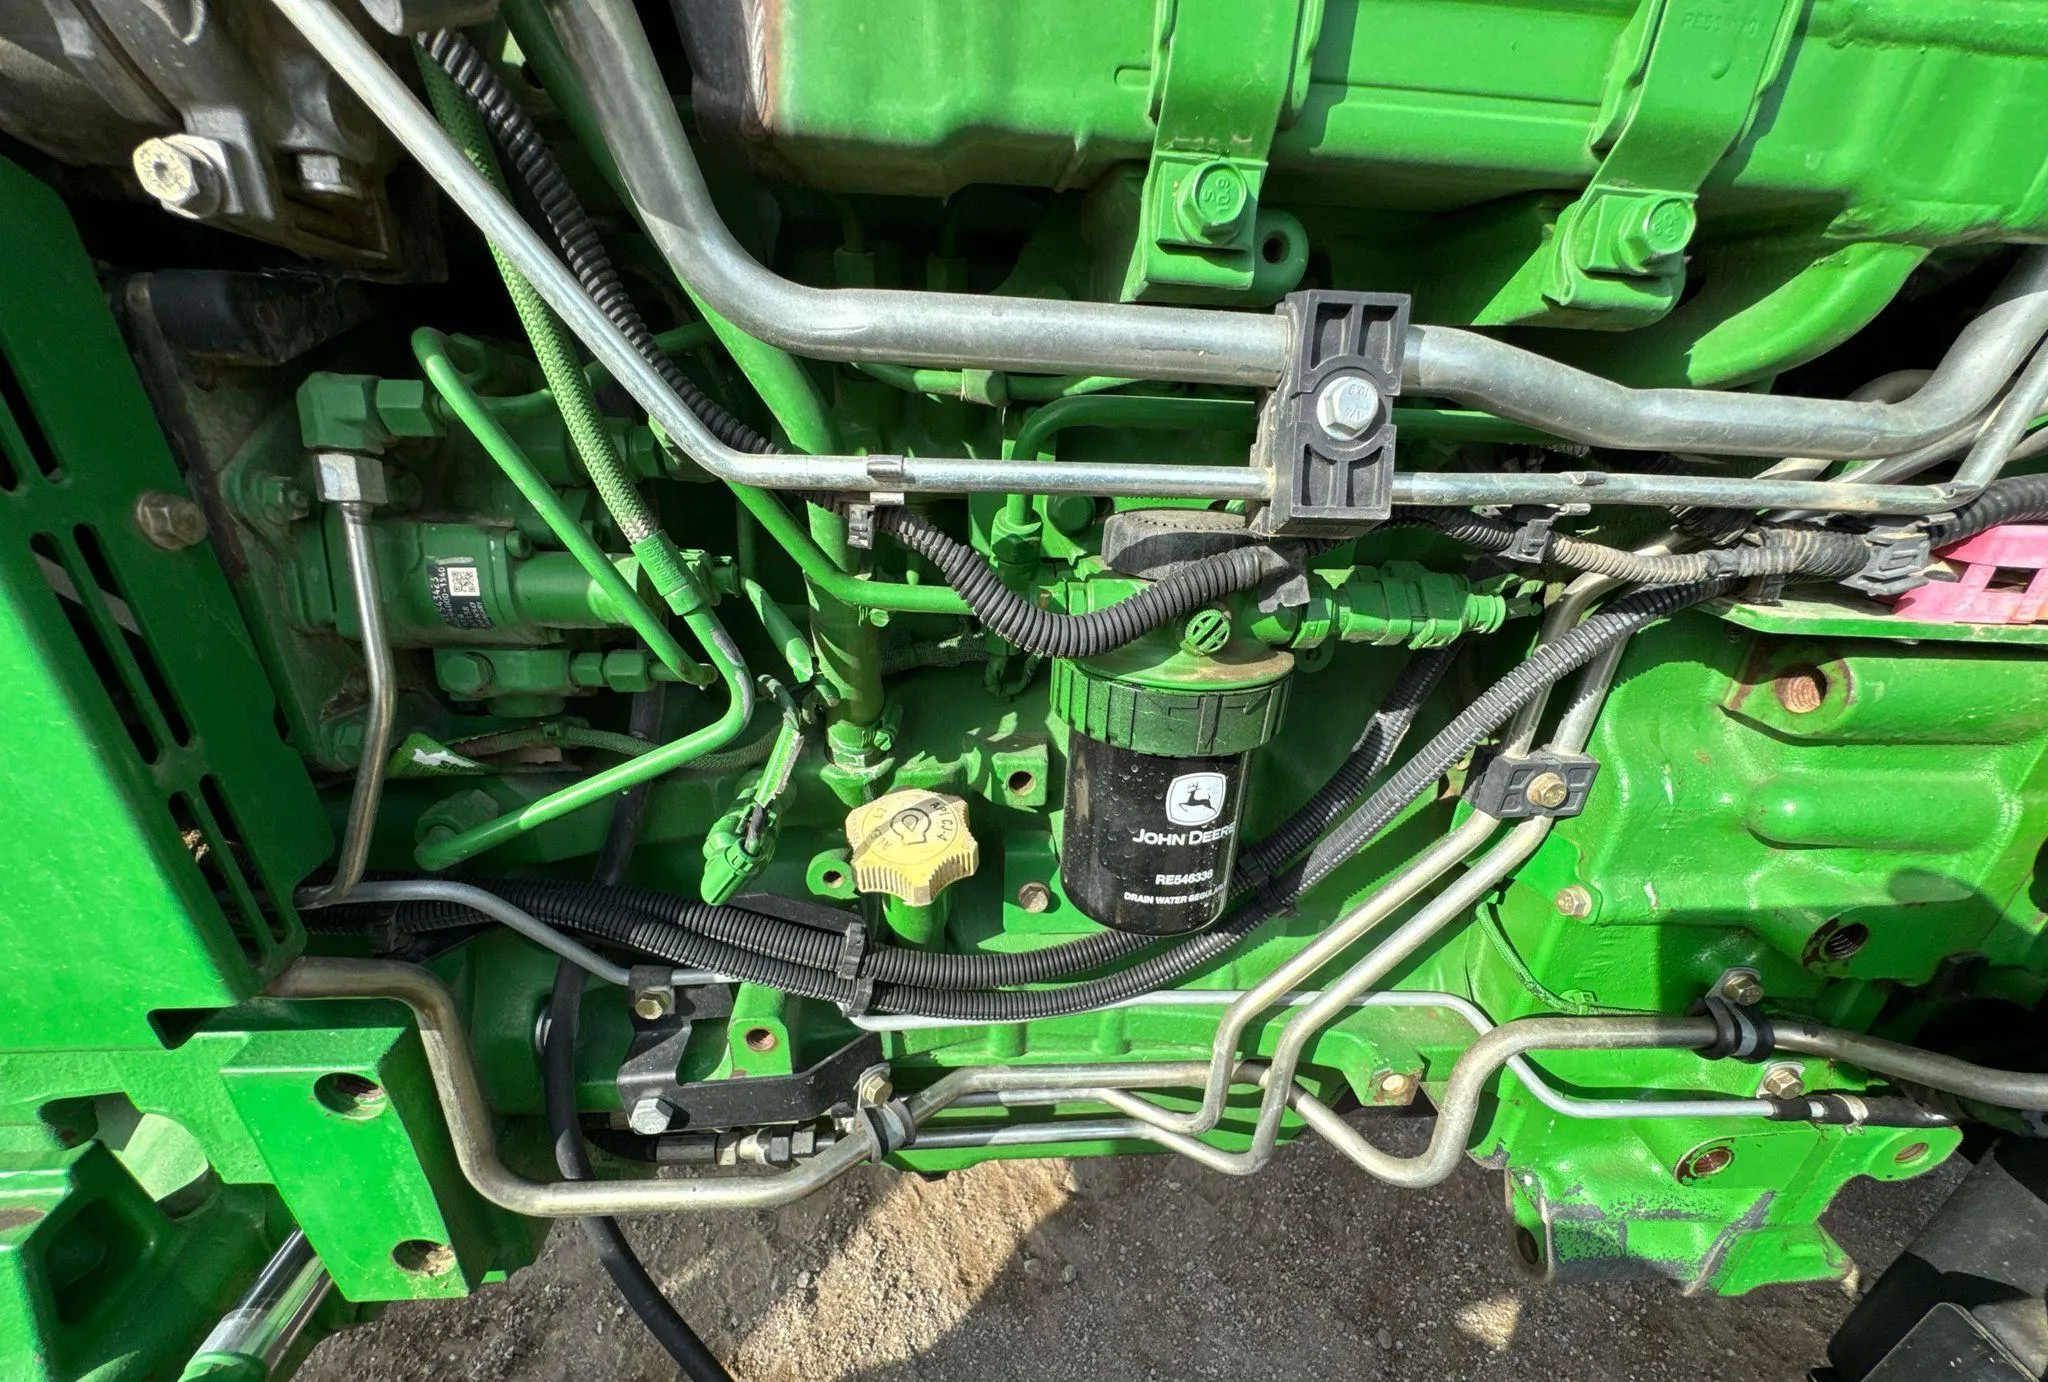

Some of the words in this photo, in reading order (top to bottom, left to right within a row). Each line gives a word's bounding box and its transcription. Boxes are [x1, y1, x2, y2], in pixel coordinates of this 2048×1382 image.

[929, 801, 948, 817] API
[936, 818, 954, 842] CJ-4
[1132, 829, 1186, 846] JOHN
[1188, 821, 1236, 845] DEERE
[1155, 869, 1213, 885] RE546336
[1124, 892, 1154, 904] DRAIN
[1156, 894, 1187, 904] WATER
